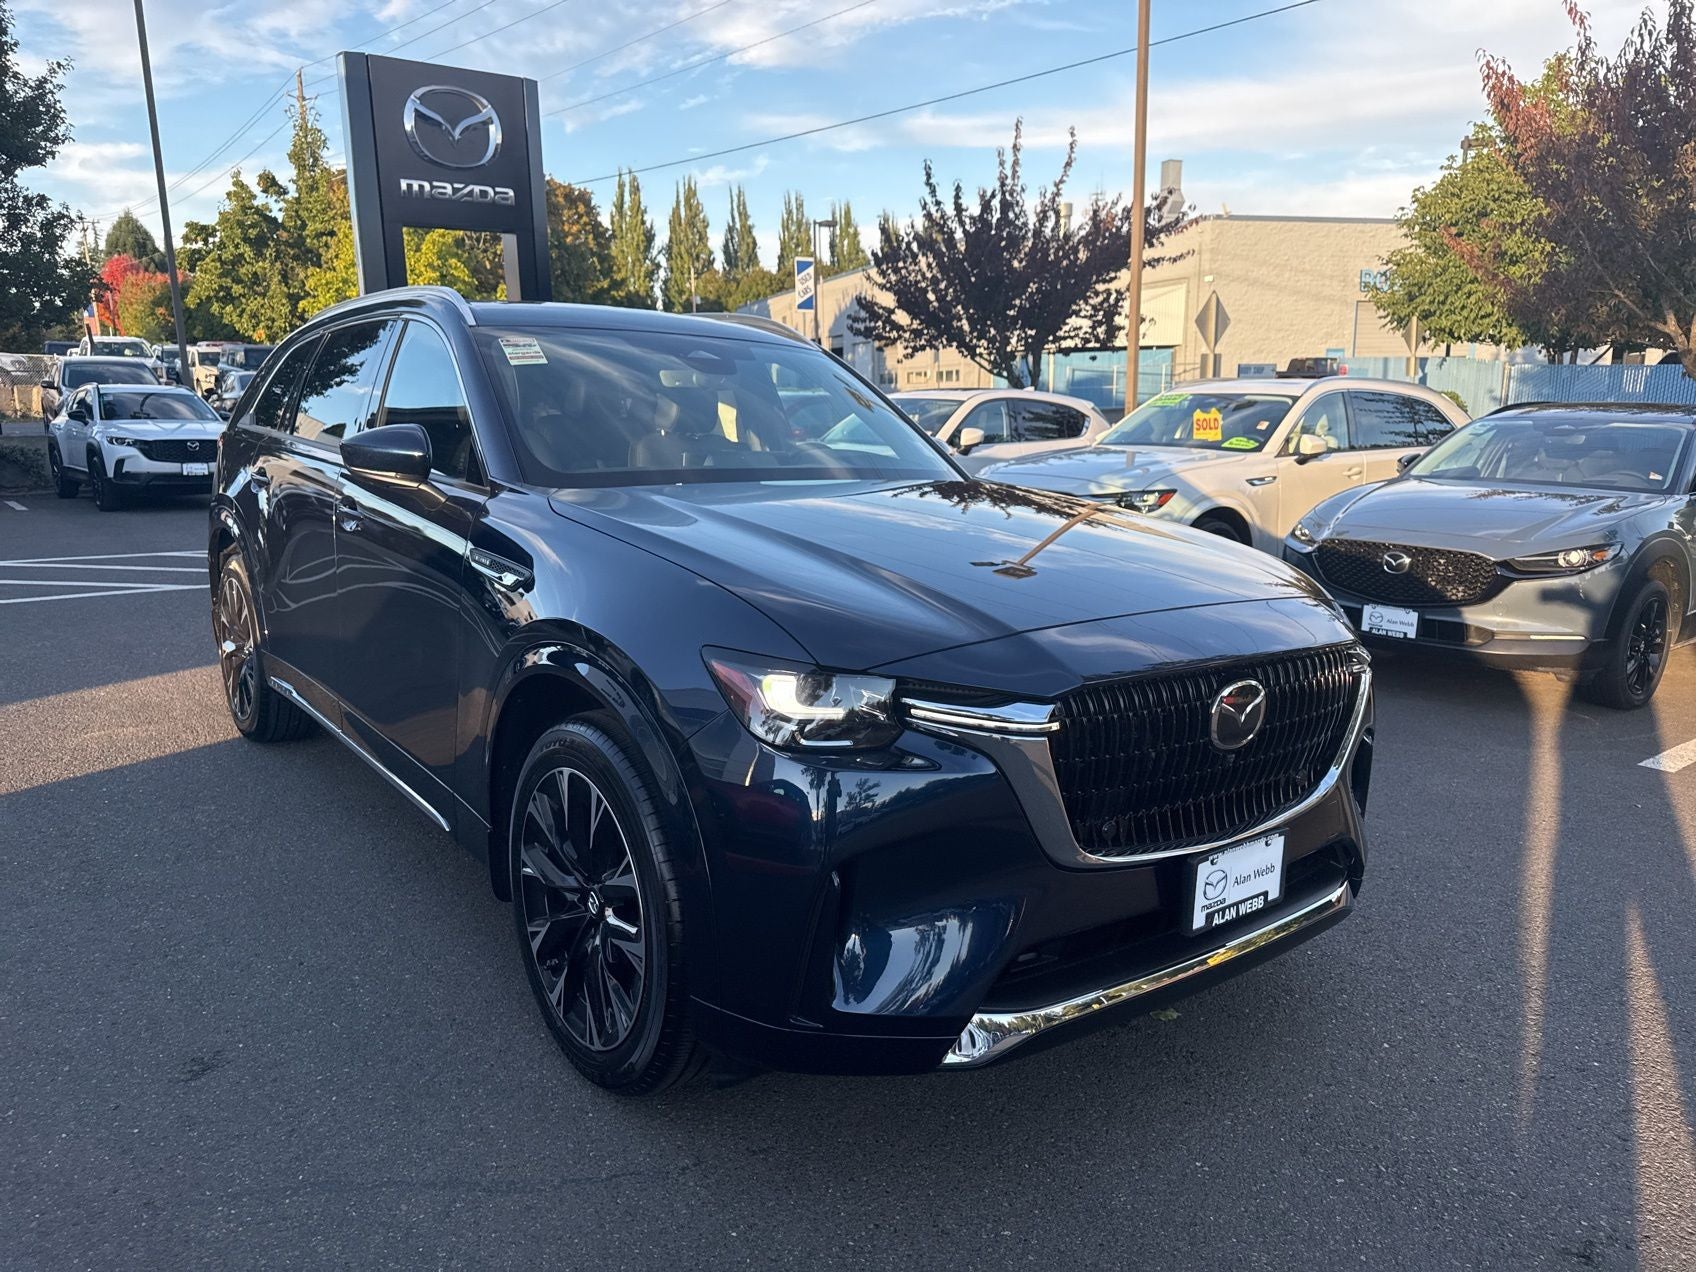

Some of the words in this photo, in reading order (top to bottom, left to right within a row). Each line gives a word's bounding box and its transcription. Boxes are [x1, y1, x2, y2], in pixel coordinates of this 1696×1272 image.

[400, 178, 515, 206] mazda
[1195, 418, 1220, 431] SOLD
[1387, 630, 1404, 638] WEBB
[1232, 873, 1251, 887] Alan
[1253, 862, 1276, 880] Webb
[1200, 897, 1227, 913] mazda
[1212, 905, 1237, 927] ALAN
[1238, 895, 1265, 916] WEBB
